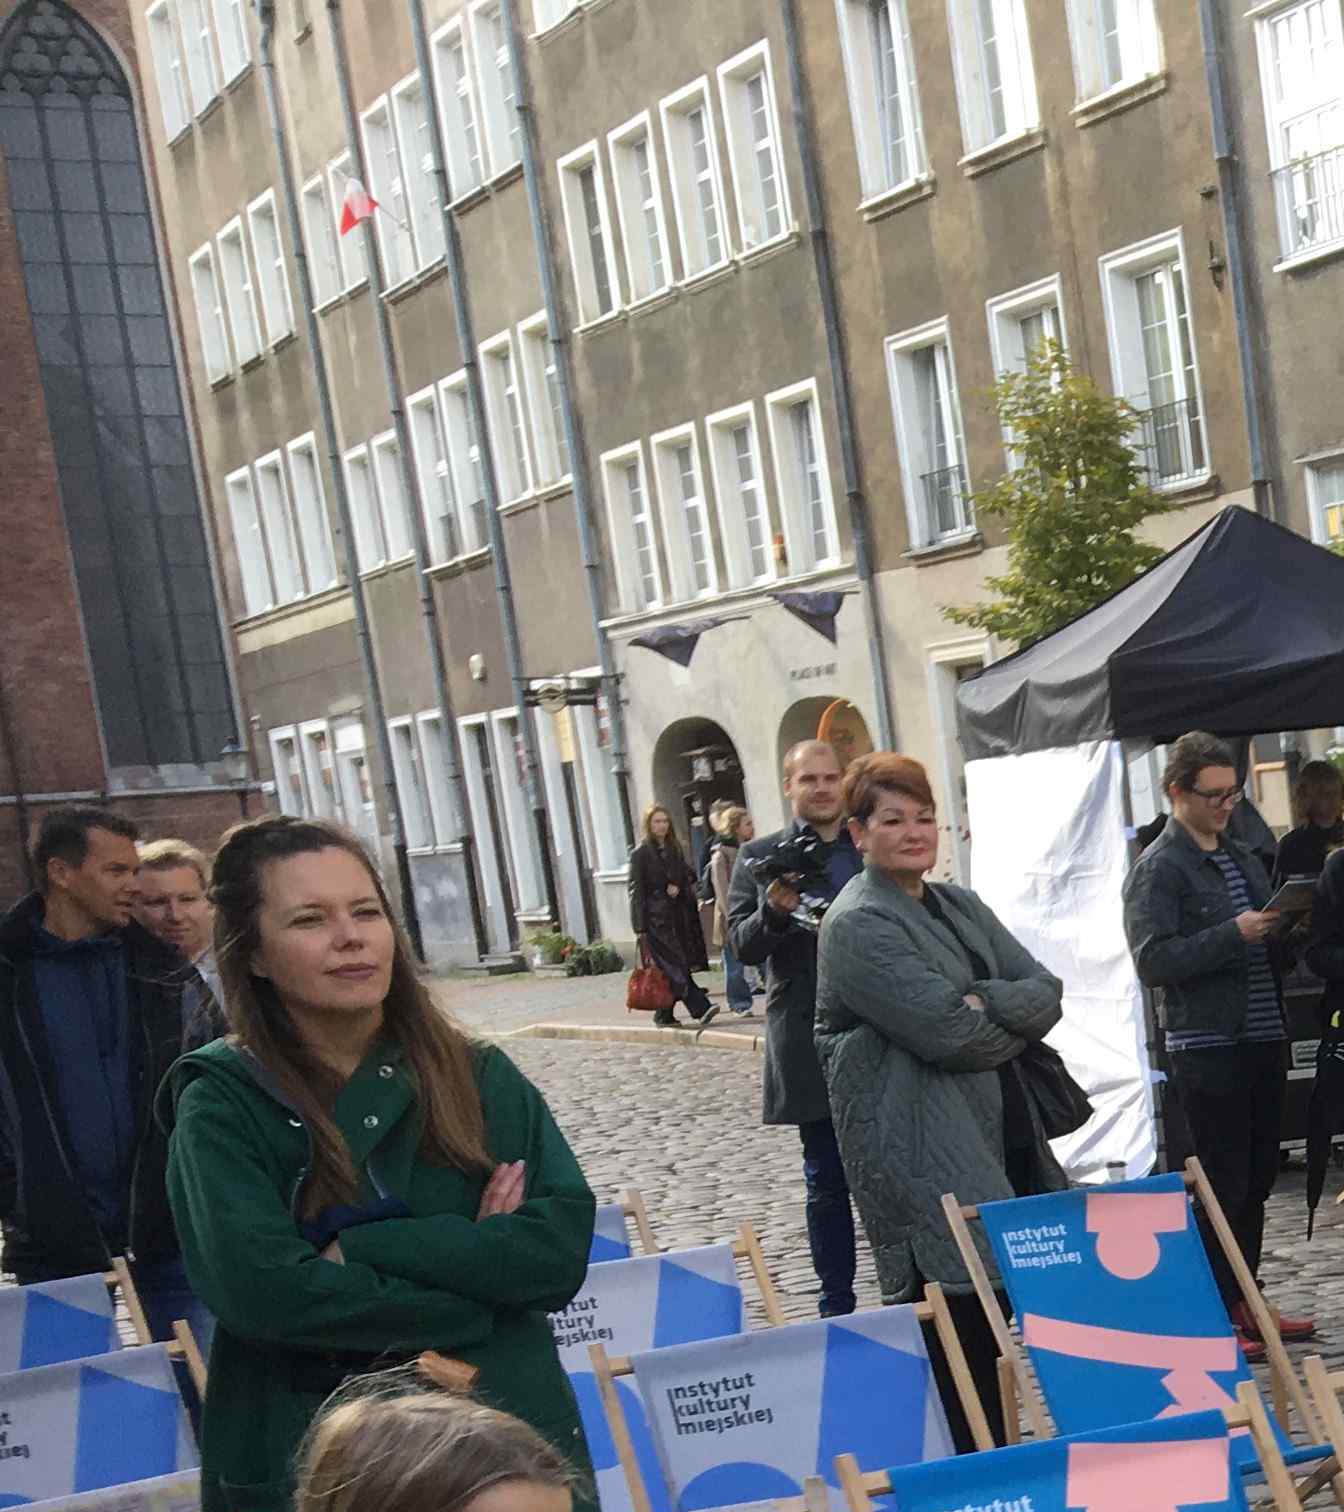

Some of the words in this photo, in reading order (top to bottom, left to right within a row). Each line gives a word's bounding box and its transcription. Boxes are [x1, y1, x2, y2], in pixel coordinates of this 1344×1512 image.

[1002, 1223, 1068, 1242] Instytut
[1008, 1239, 1065, 1255] kultury
[1011, 1250, 1083, 1269] miejskiej
[667, 1372, 756, 1401] Instytut
[673, 1393, 751, 1417] kultury
[676, 1407, 774, 1435] miejskiej
